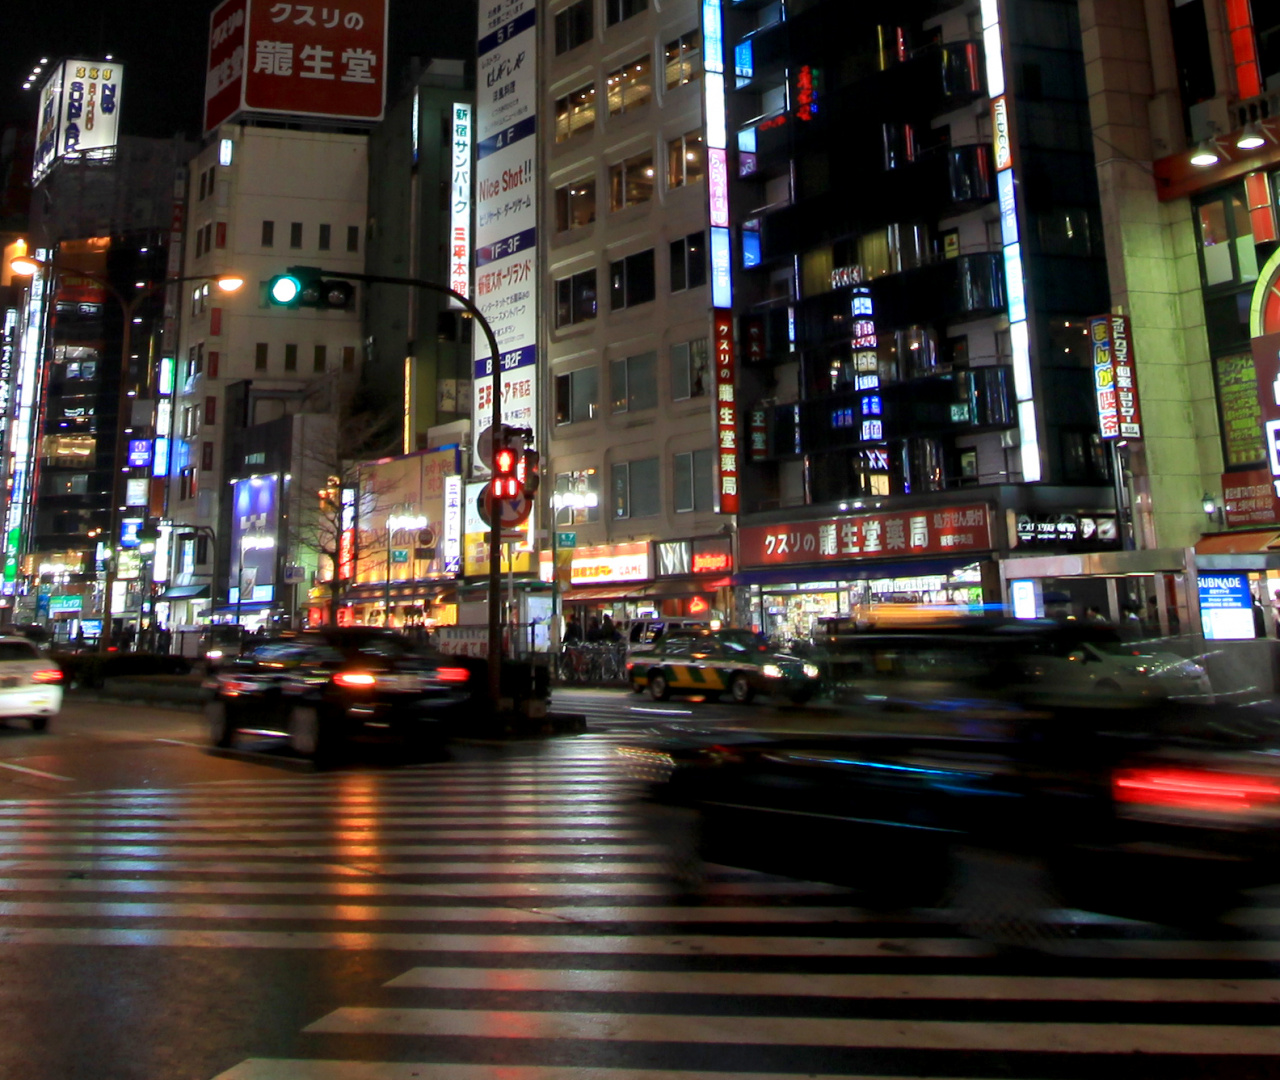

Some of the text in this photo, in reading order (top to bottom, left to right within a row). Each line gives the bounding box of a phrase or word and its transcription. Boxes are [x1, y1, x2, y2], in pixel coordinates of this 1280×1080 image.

[269, 2, 365, 30] クスリの
[496, 22, 515, 44] 5F
[252, 39, 377, 85] 龍生堂
[64, 81, 85, 153] SUNPAR
[495, 126, 515, 148] 4F
[478, 158, 533, 204] Nice Shot!!
[452, 107, 469, 296] 新宿サンパーク 三平本館
[483, 303, 527, 326] ミューズメントパーク
[1093, 322, 1119, 435] まんが喫茶
[933, 510, 982, 529] 処方せん受付
